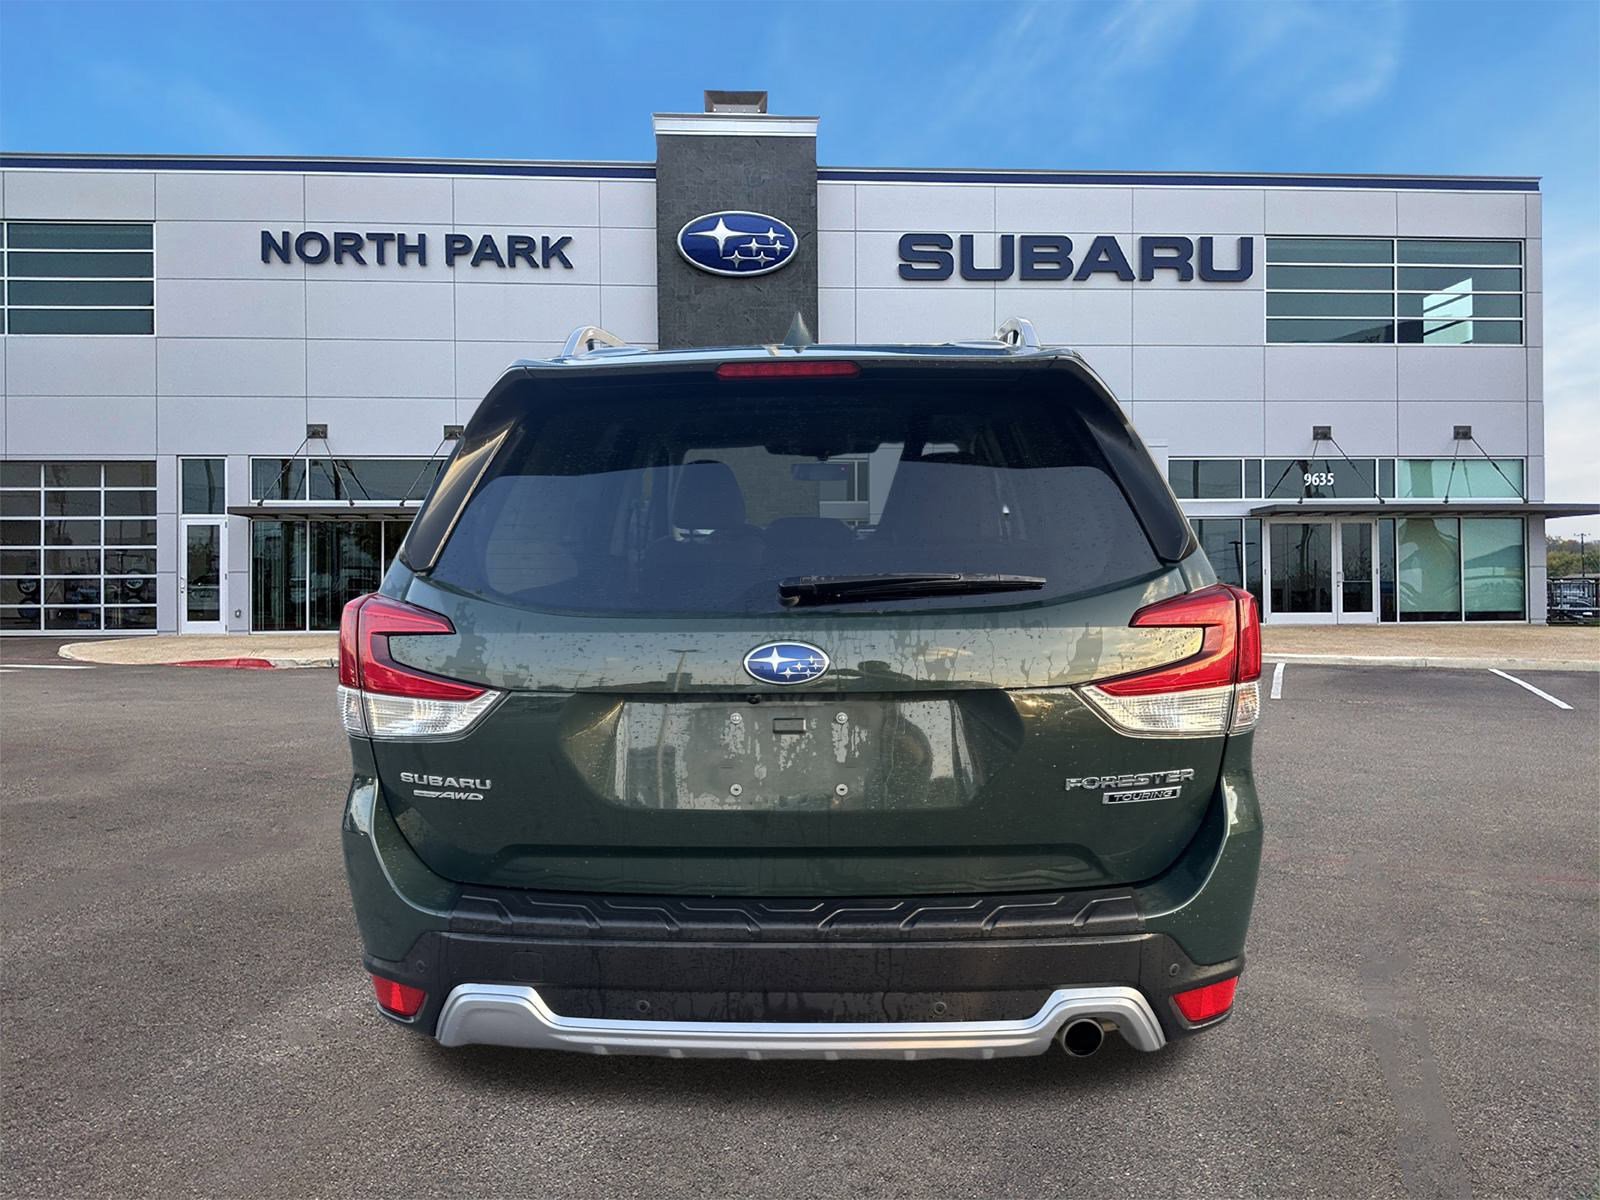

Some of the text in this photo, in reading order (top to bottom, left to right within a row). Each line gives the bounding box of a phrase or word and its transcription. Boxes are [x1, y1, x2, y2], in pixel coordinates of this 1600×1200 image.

[261, 231, 574, 269] NORTH PARK
[898, 233, 1254, 282] SUBARU
[1303, 472, 1335, 487] 9635
[400, 772, 492, 789] SUBARU
[1065, 768, 1195, 790] FORESTER
[1113, 789, 1173, 802] TOURING
